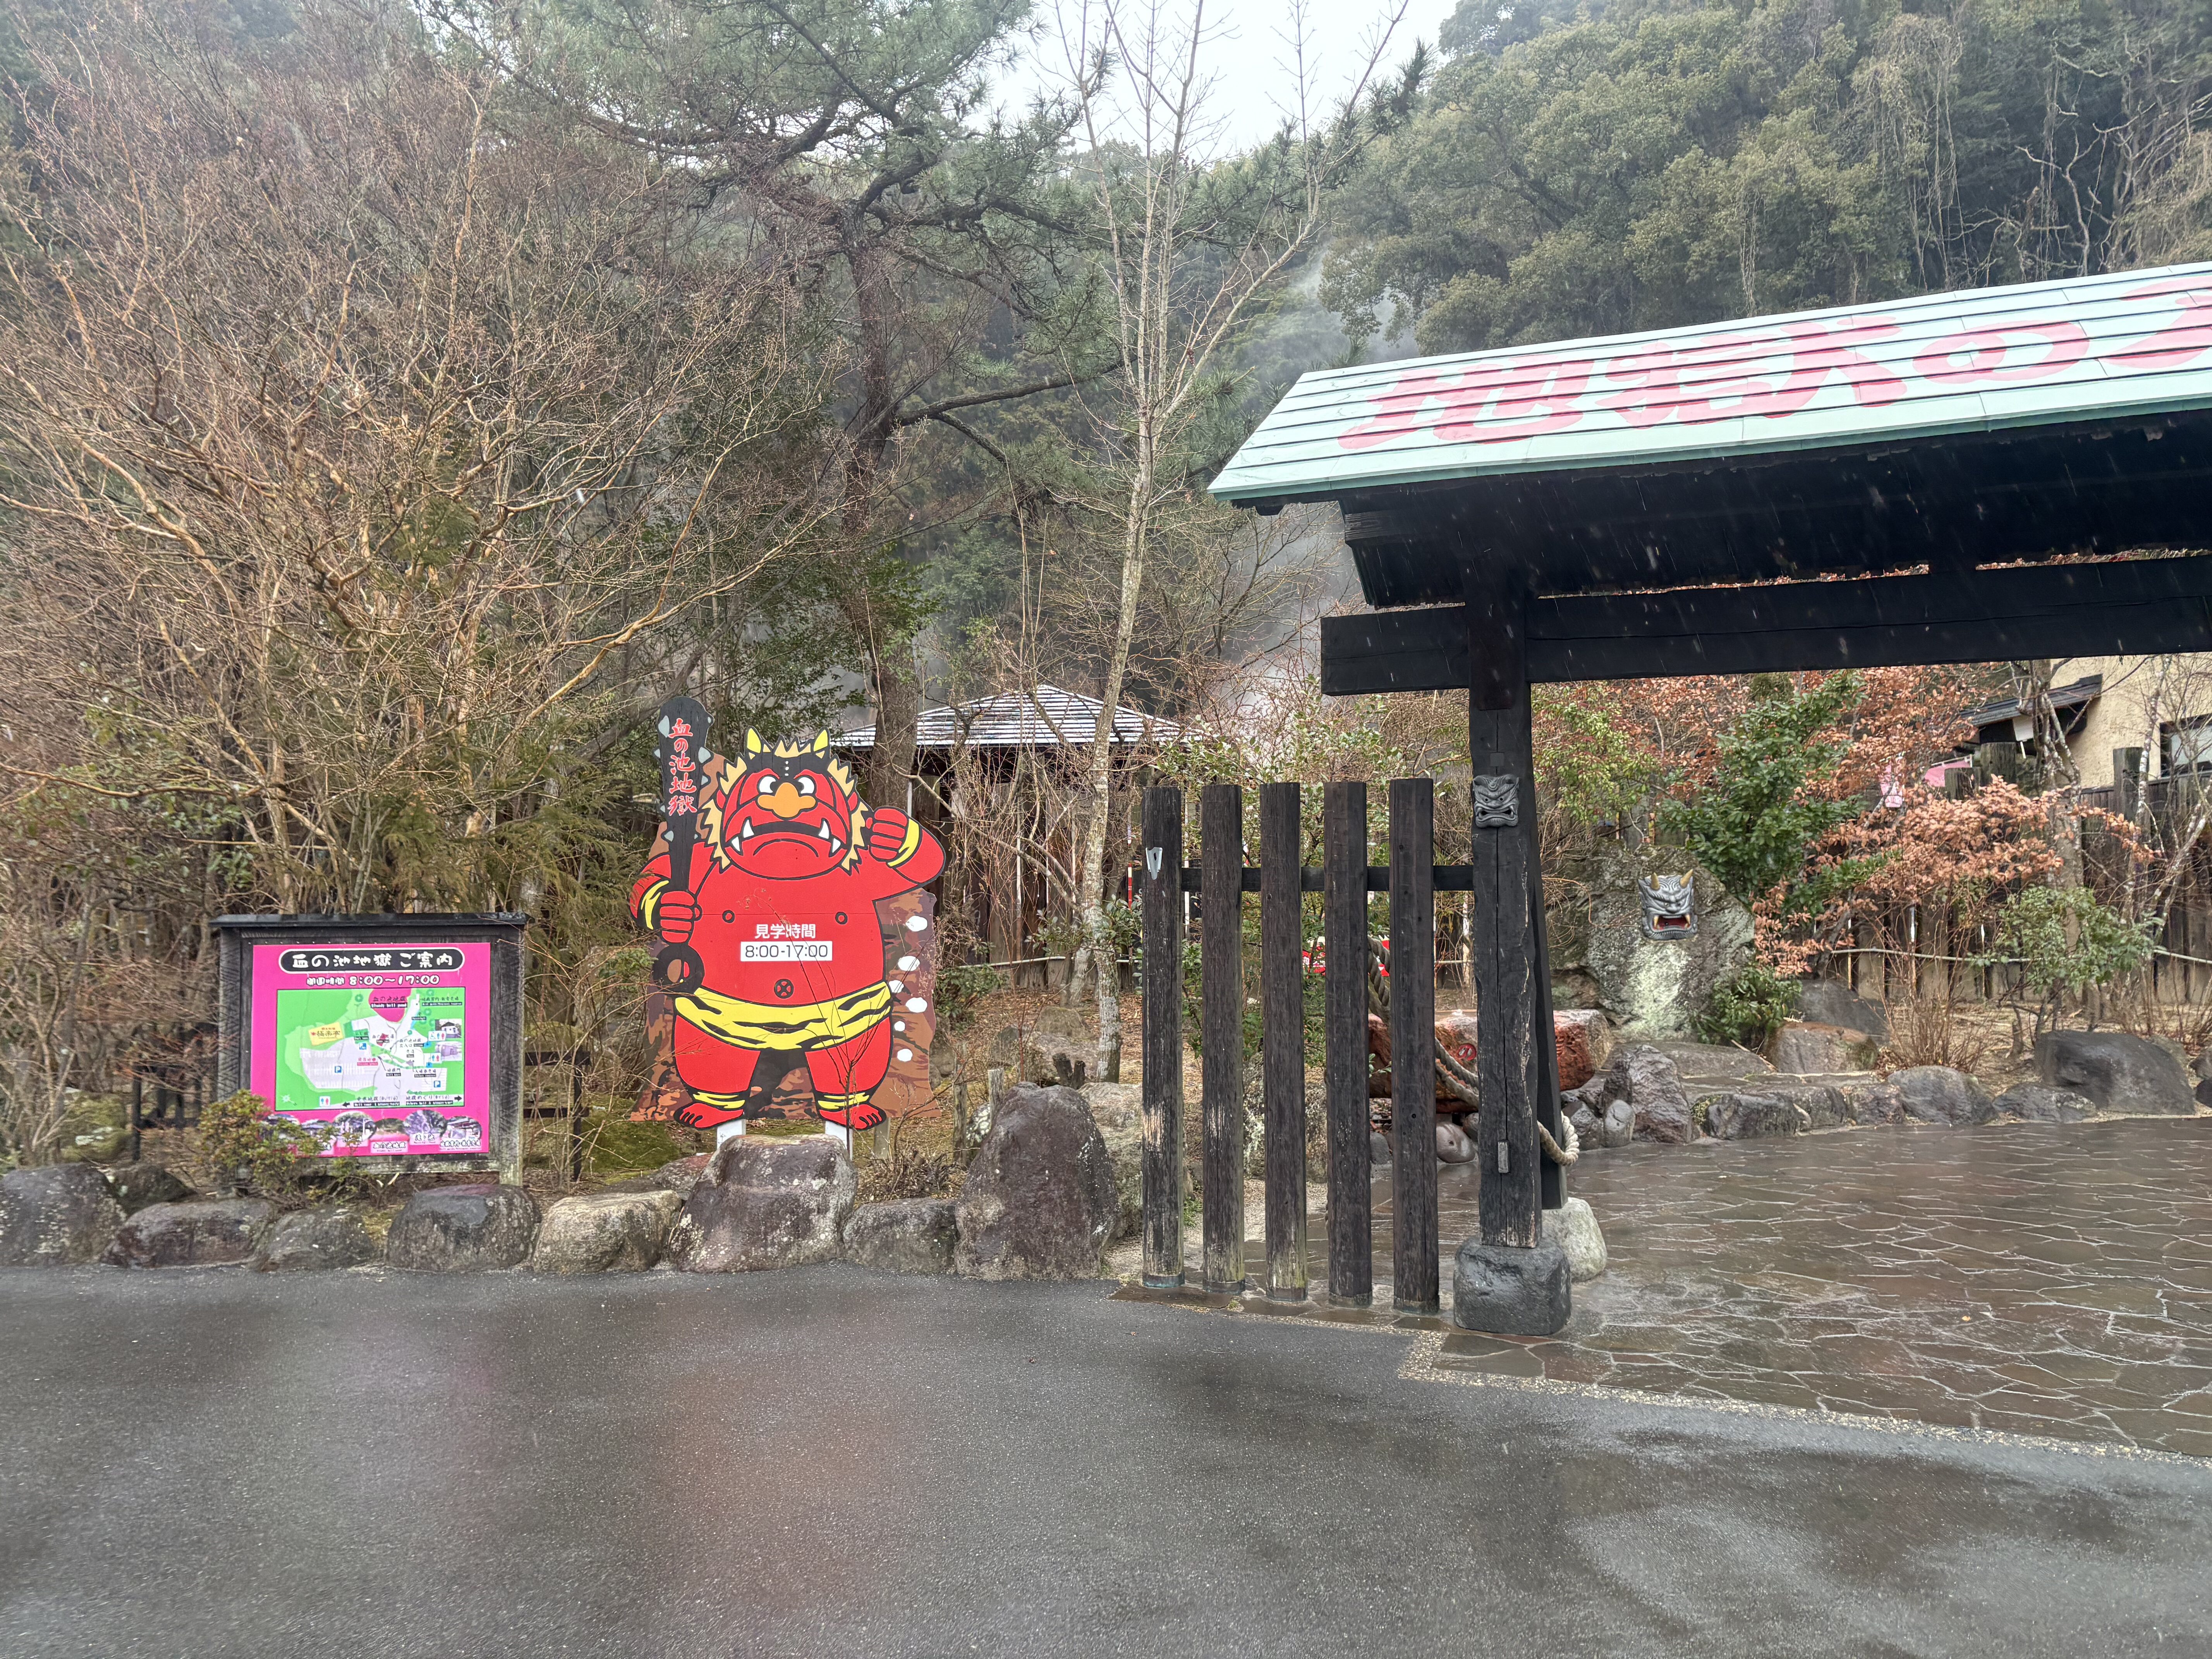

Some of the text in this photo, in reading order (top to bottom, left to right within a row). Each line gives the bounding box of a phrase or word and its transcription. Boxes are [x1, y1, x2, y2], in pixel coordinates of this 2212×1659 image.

[668, 718, 697, 816] 血の池地獄
[755, 924, 816, 939] 見学時間
[745, 945, 828, 957] 8:00-17:00
[292, 951, 452, 968] 血の池地獄 ご案内
